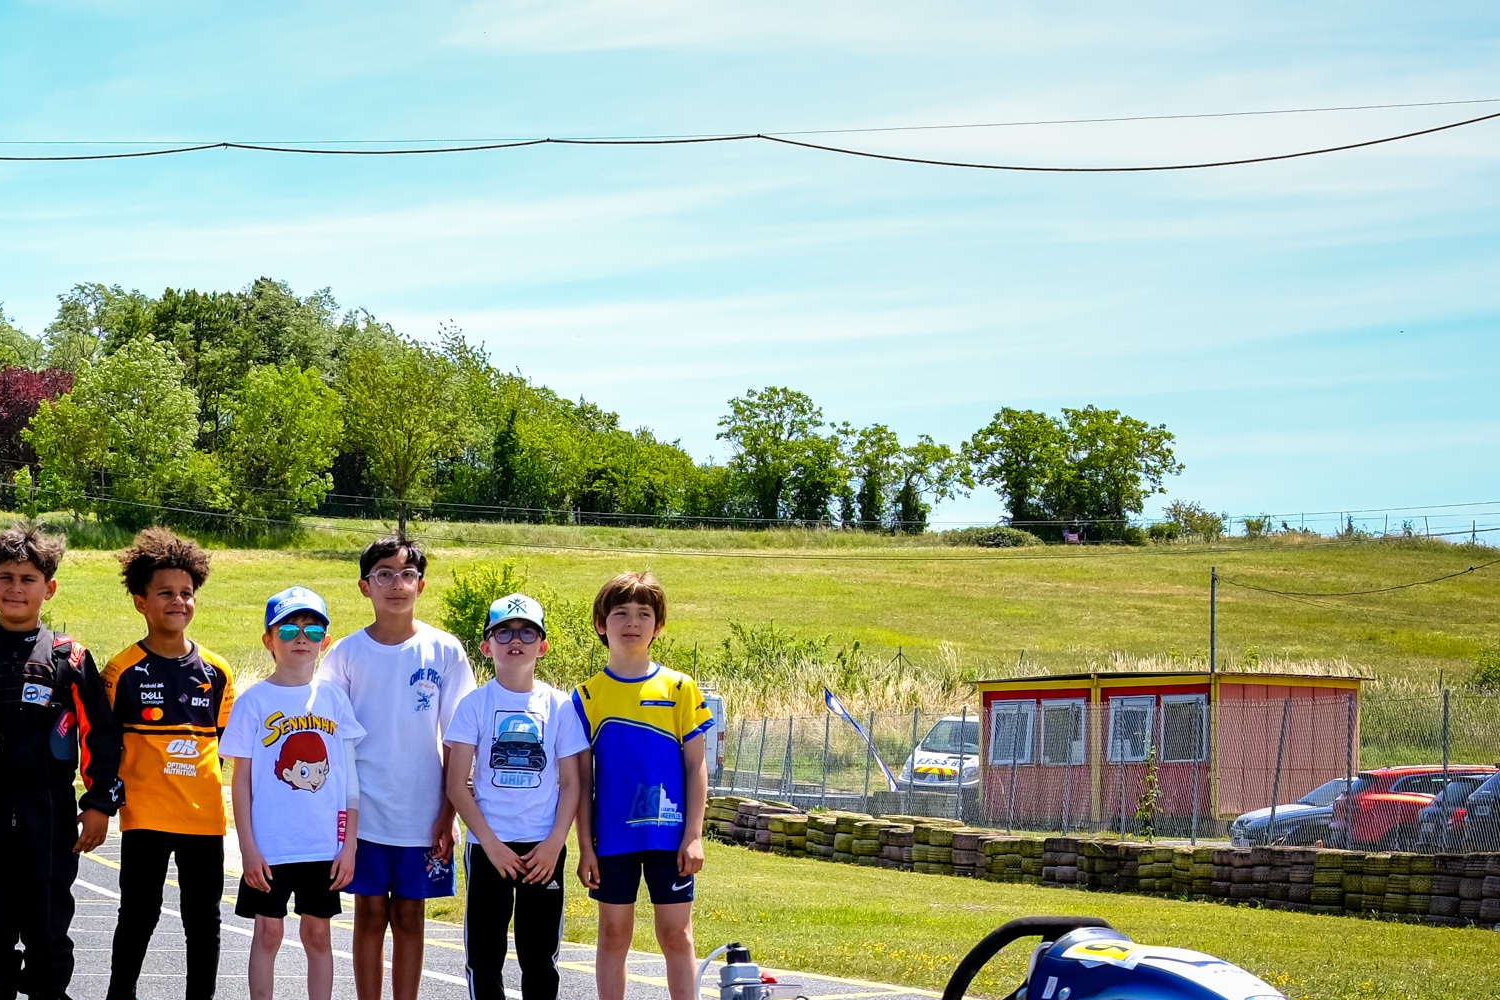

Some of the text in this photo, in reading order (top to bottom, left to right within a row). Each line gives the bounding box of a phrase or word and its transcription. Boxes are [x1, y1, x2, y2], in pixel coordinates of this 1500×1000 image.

[409, 668, 425, 686] ONE
[140, 691, 163, 701] DELL
[165, 739, 199, 755] ON
[166, 761, 196, 770] OPTIMUM
[163, 767, 197, 778] NUTRITION
[499, 773, 535, 787] DRIFT
